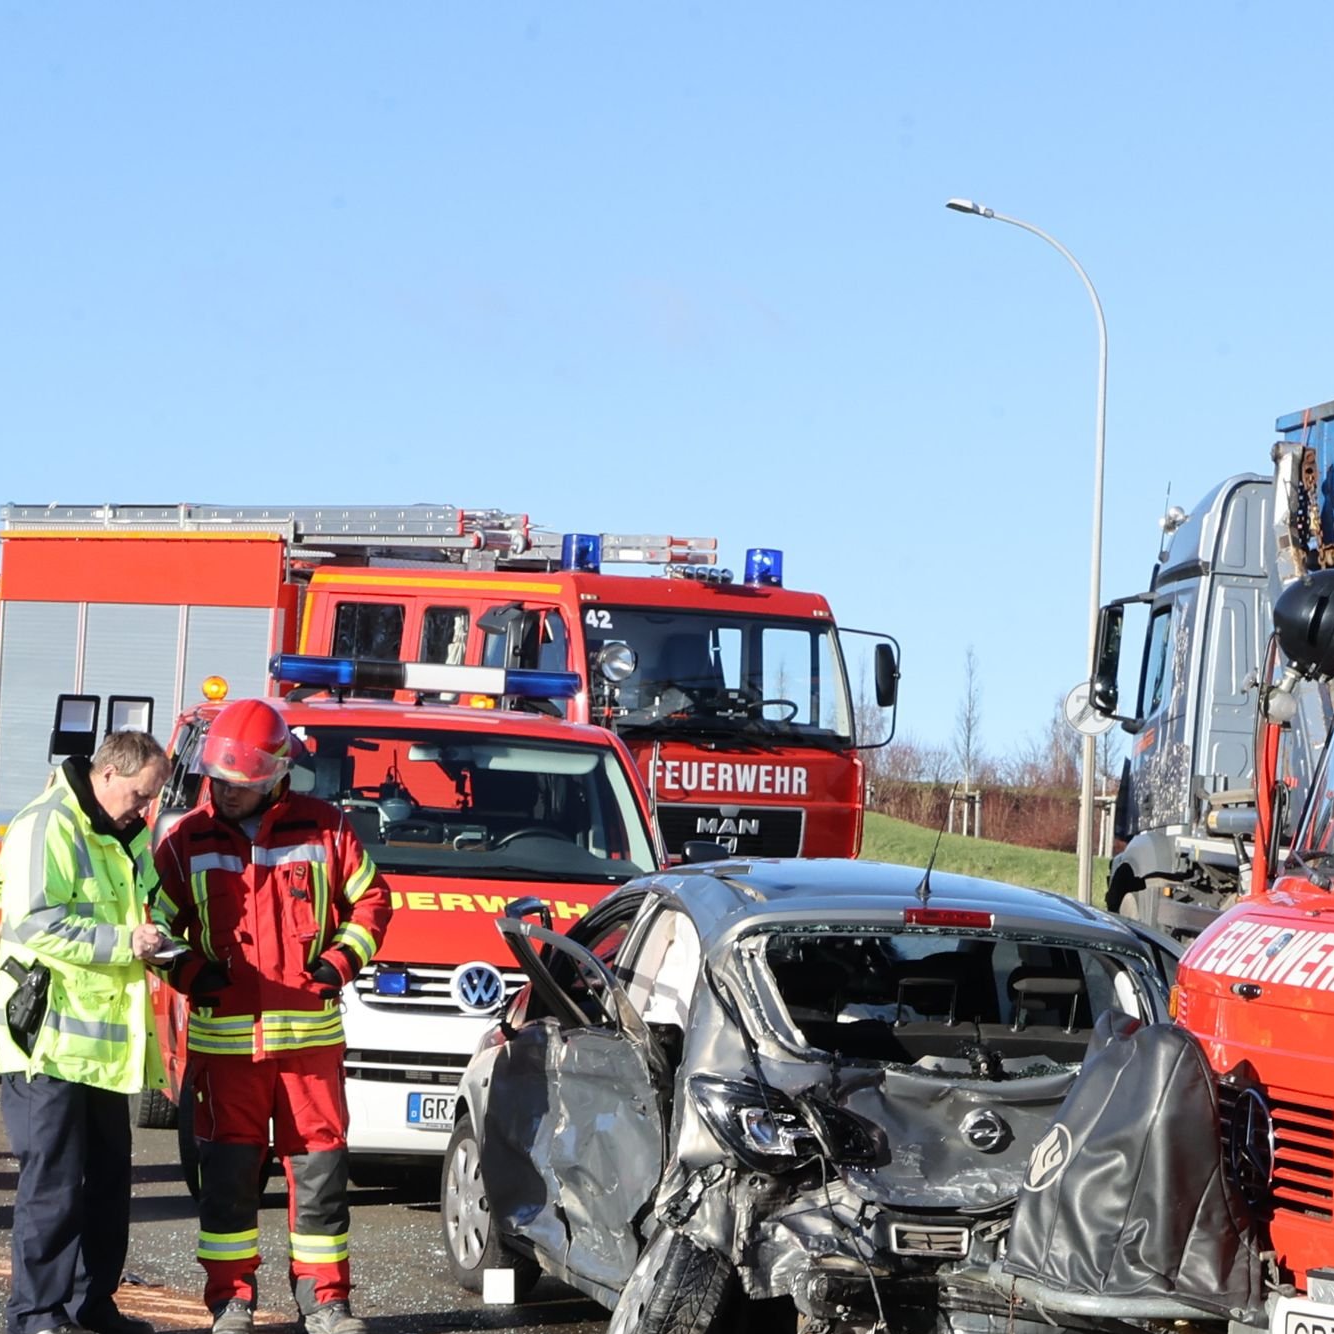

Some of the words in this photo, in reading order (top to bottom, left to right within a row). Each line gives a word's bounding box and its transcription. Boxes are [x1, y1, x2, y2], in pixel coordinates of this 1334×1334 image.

[585, 609, 614, 630] 42
[648, 759, 808, 796] FEUERWEHR
[696, 817, 760, 835] MAN
